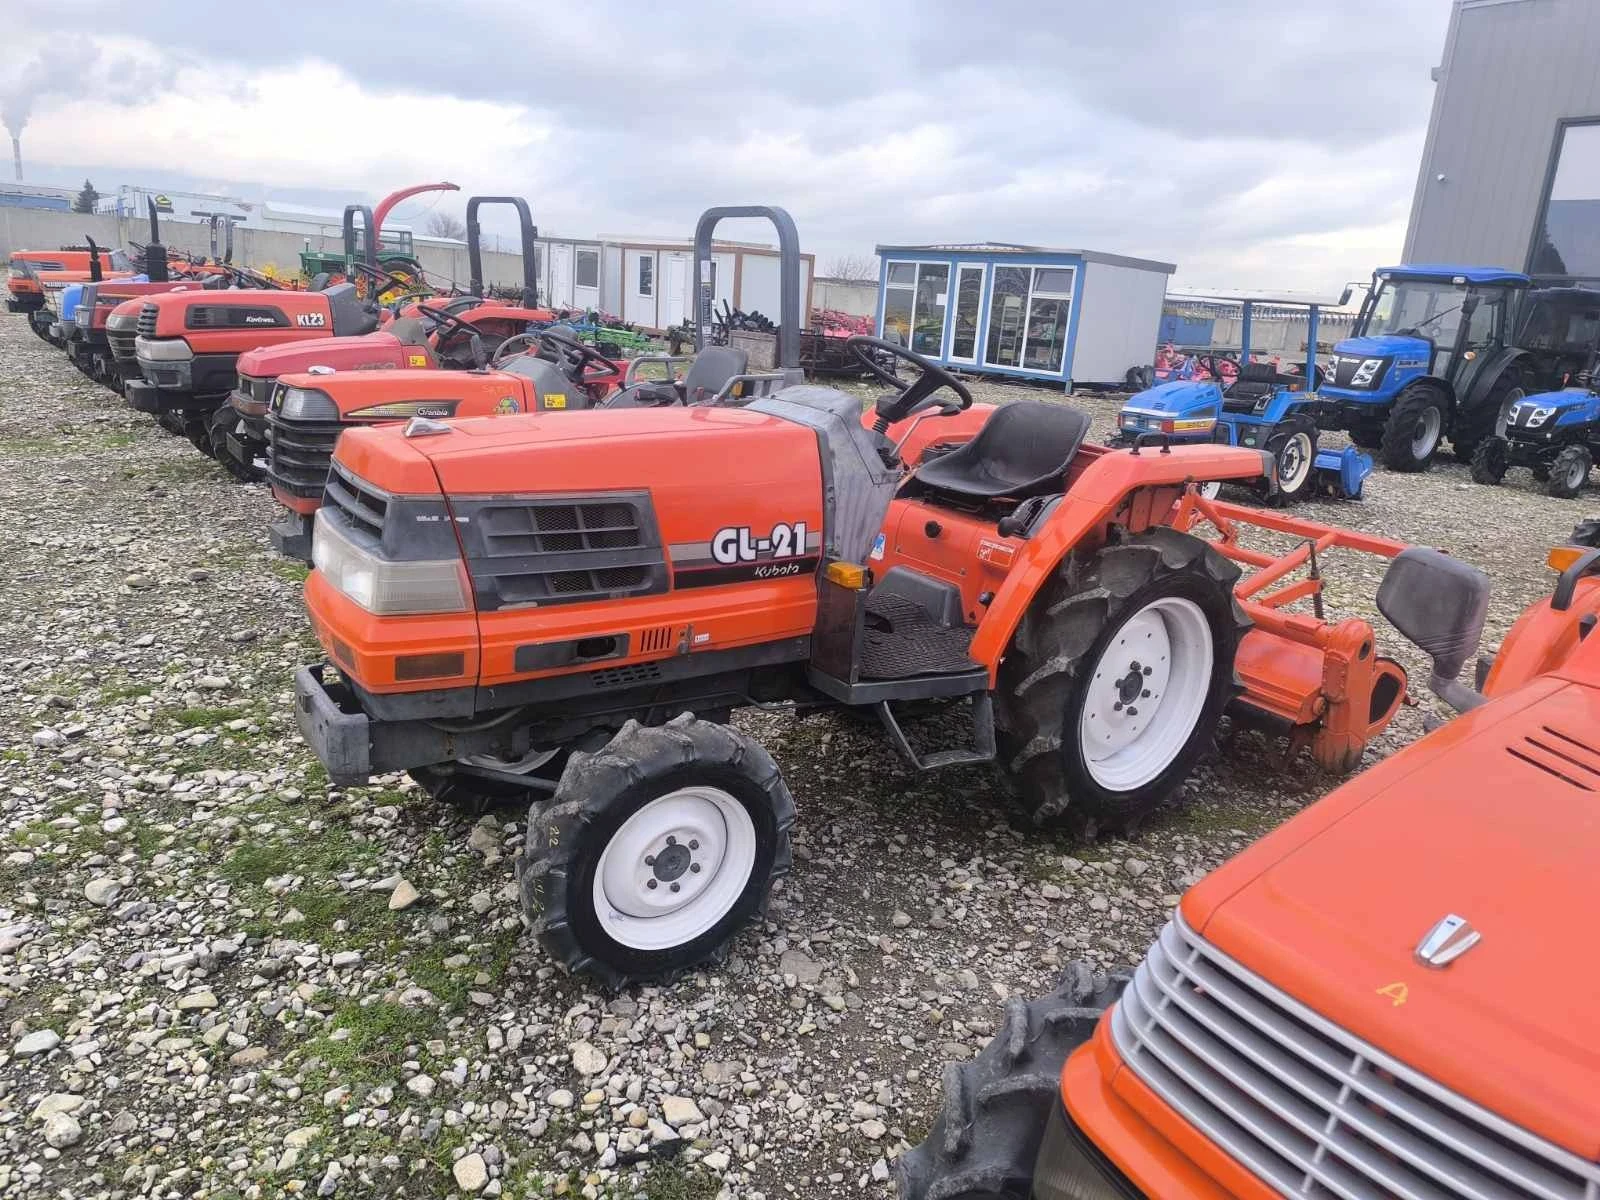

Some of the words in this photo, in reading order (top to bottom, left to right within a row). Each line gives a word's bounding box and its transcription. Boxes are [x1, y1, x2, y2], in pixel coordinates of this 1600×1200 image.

[296, 312, 324, 326] KL23
[712, 522, 806, 564] GL-21
[754, 562, 800, 577] Kubota
